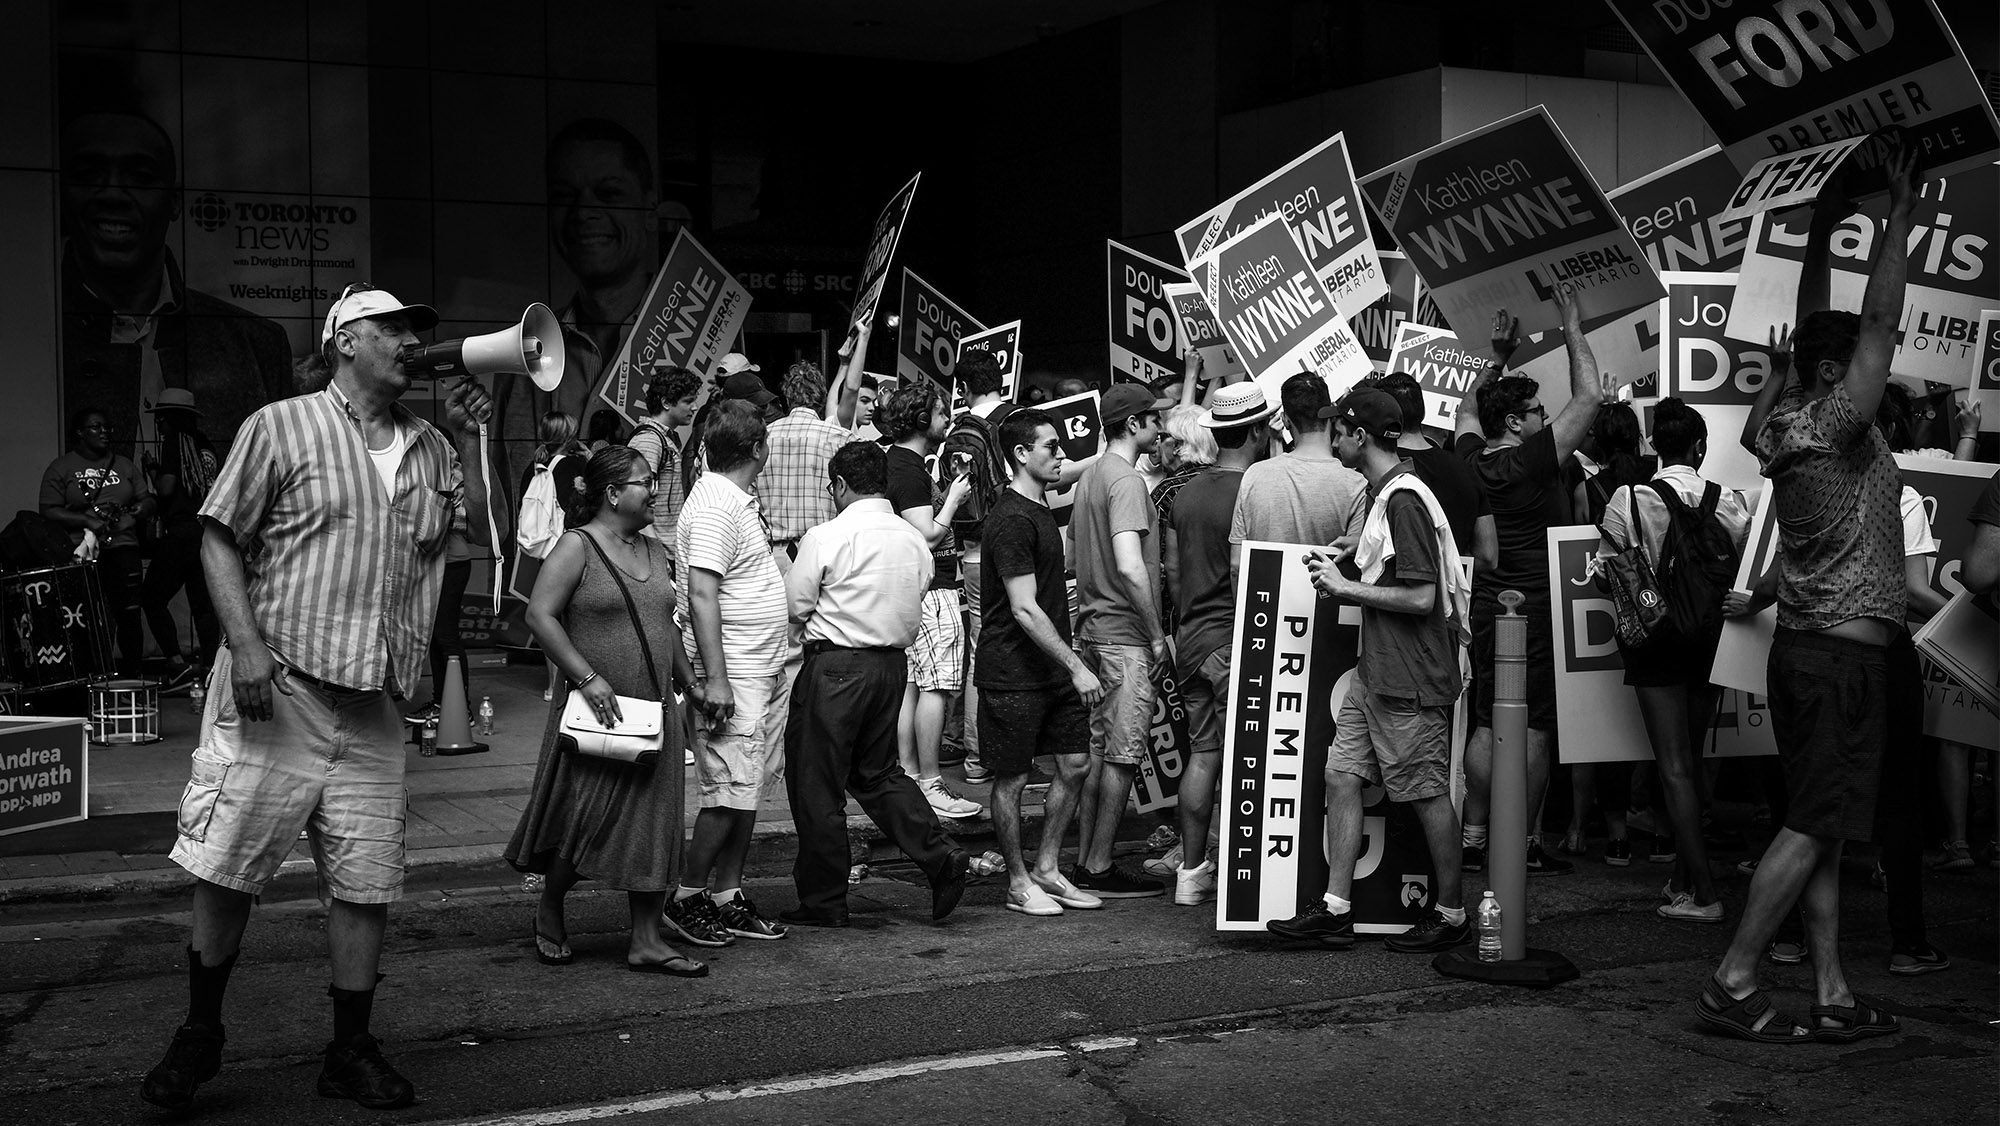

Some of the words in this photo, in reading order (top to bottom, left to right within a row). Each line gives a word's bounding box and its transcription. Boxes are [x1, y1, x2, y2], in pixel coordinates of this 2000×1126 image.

[1688, 0, 1895, 111] FORD
[1384, 172, 1408, 222] RE-ELECT
[1414, 158, 1532, 215] Kathleen
[1733, 146, 1852, 209] HELP
[235, 203, 357, 225] TORONTO
[235, 226, 330, 251] news
[1408, 176, 1596, 270] WYNNE
[233, 258, 249, 266] with
[251, 256, 290, 268] Dwight
[291, 257, 355, 269] Drummond
[813, 275, 853, 292] SRC
[1222, 254, 1285, 305] Kathleen
[1561, 263, 1641, 295] ONTARIO
[229, 284, 327, 302] Weeknights
[917, 292, 962, 341] DOUG
[1228, 270, 1326, 360] WYNNE
[632, 279, 686, 377] Kathleen
[703, 289, 737, 351] LIBERAL
[710, 294, 741, 356] ONTARIO
[1400, 334, 1431, 350] RE-ELECT
[618, 360, 629, 407] RE-ELECT
[1319, 343, 1358, 378] ONTARIO
[1251, 589, 1270, 652] FOR
[1244, 675, 1263, 732] THE
[1267, 615, 1308, 859] PREMIER
[0, 763, 72, 795] orwath
[32, 790, 62, 808] NPD
[1237, 755, 1258, 882] PEOPLE
